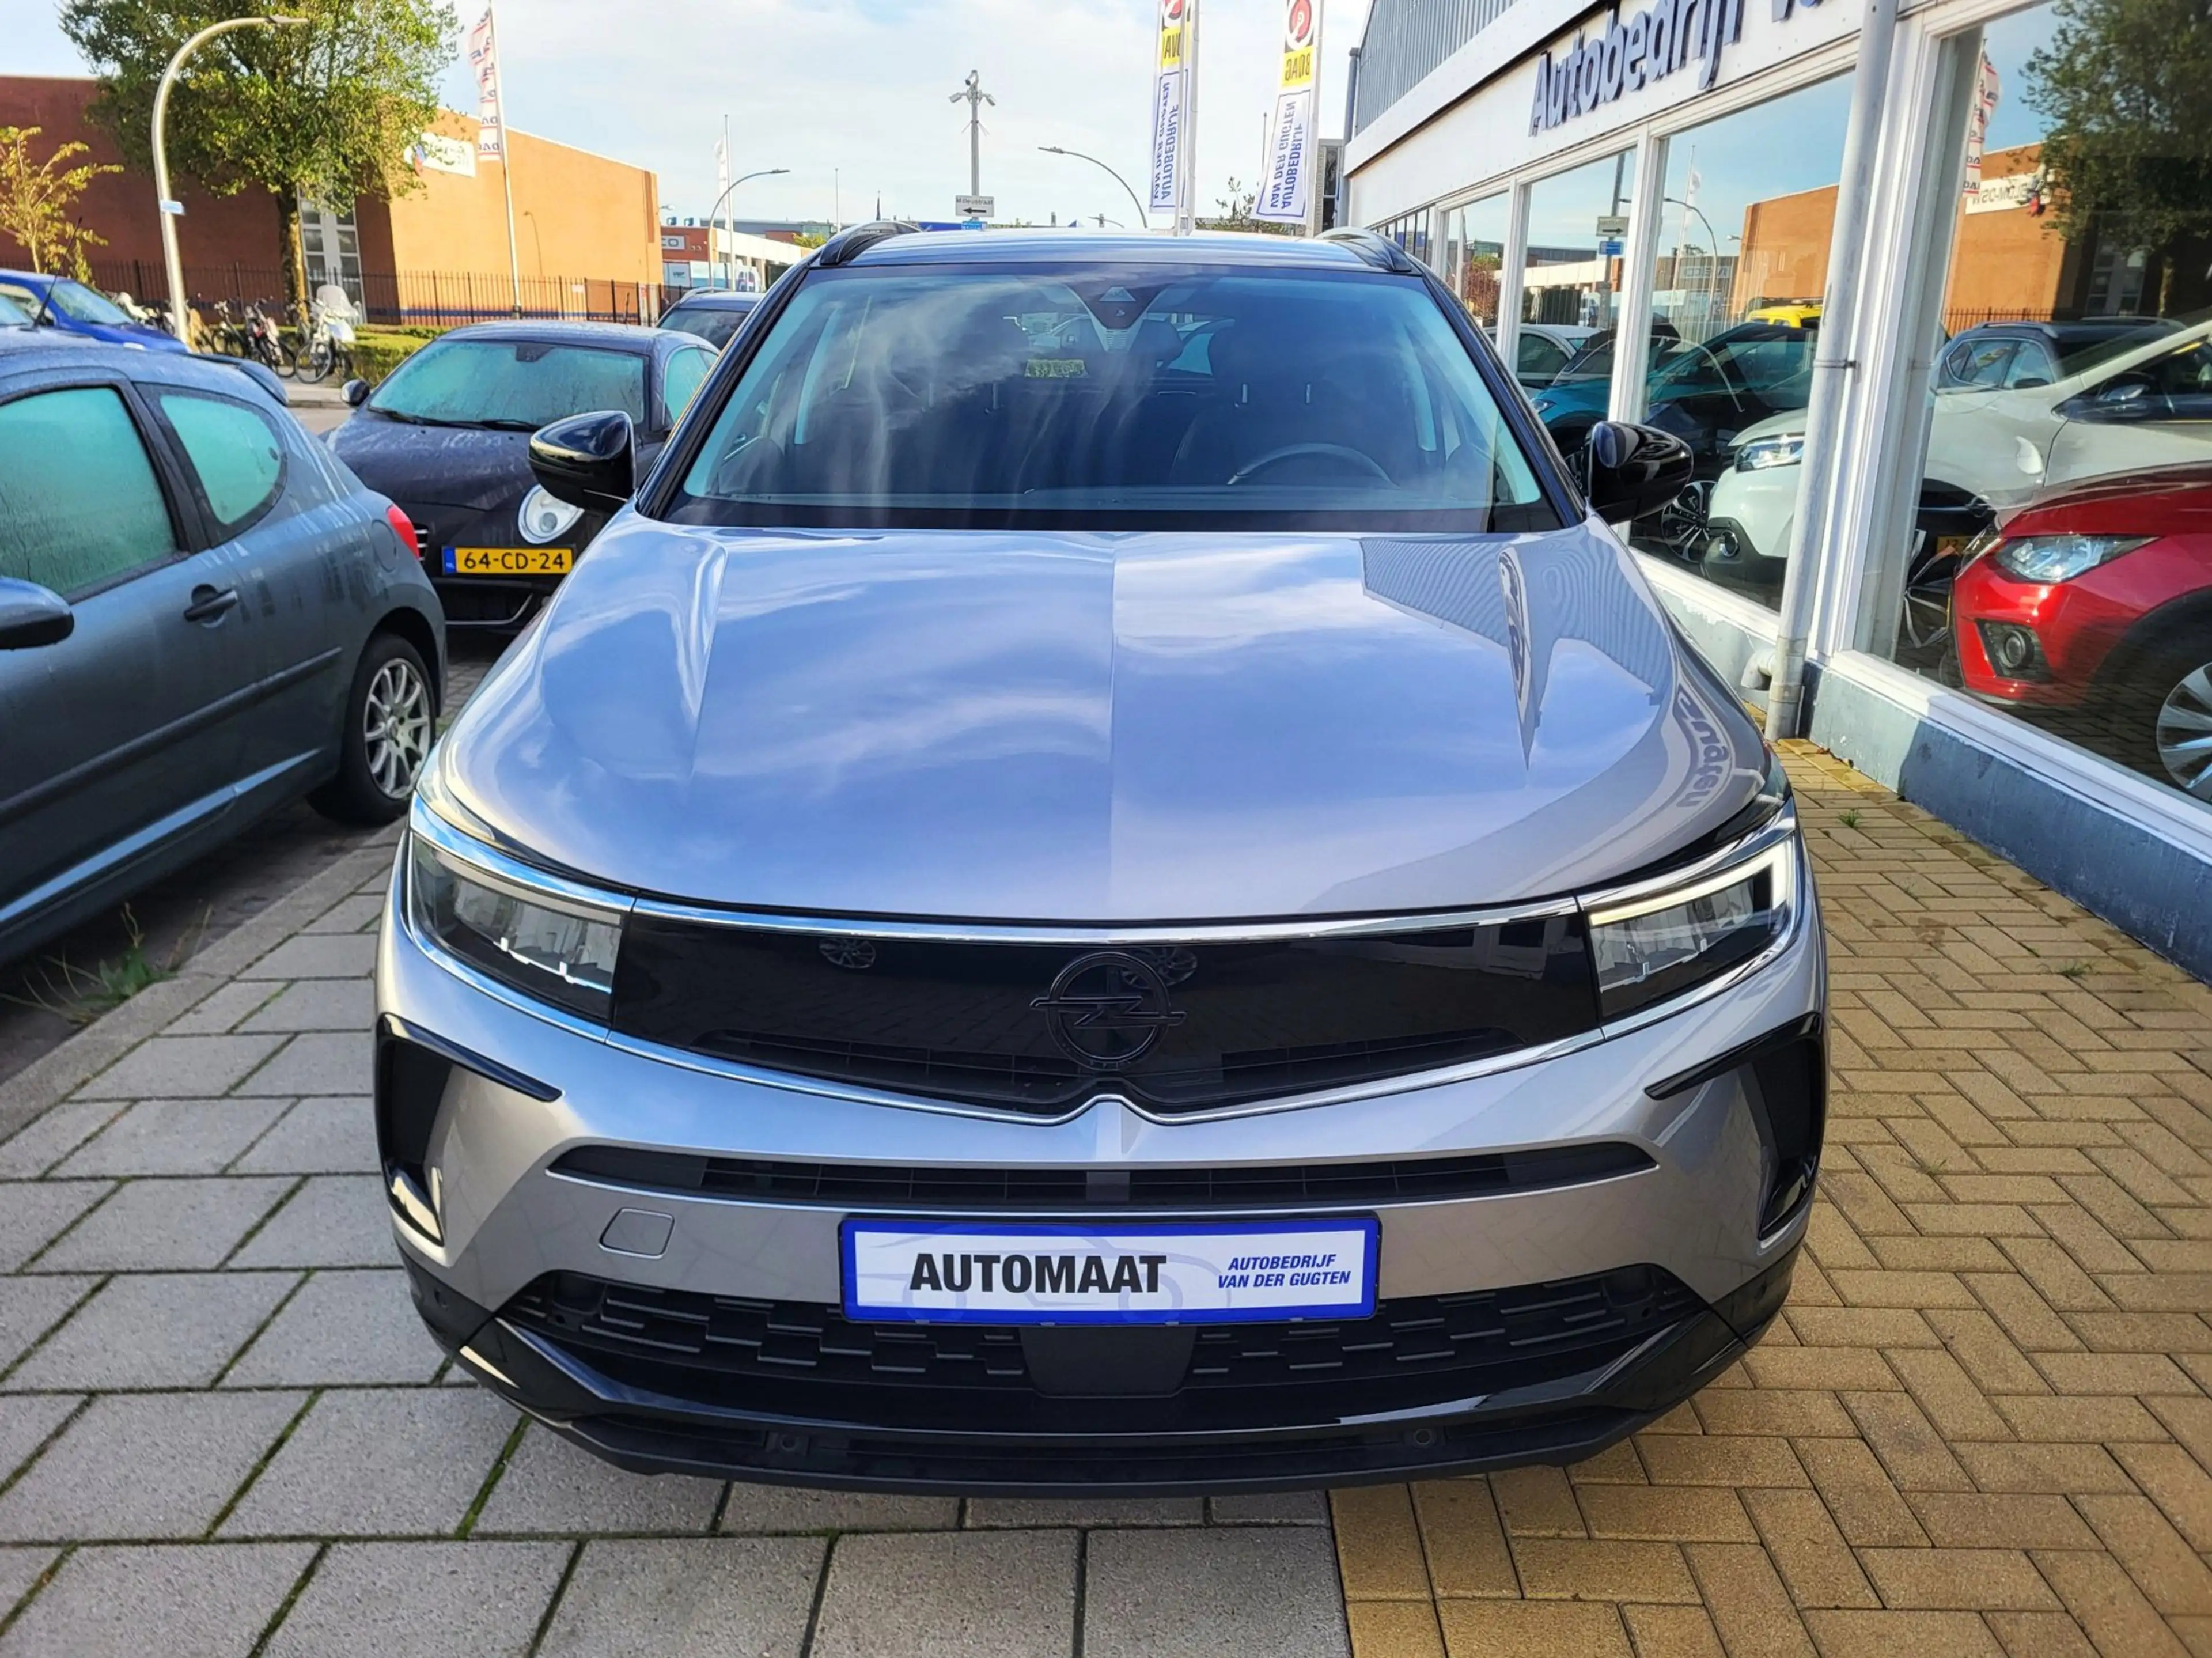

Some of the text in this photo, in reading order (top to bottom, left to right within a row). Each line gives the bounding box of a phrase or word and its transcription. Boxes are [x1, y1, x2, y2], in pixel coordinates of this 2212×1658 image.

[464, 551, 565, 570] 64-CD-24
[1228, 1254, 1337, 1271] AUTOBEDRIJF
[910, 1252, 1168, 1294] AUTOMAAT
[1218, 1270, 1352, 1289] VAN DER GUGTEN
